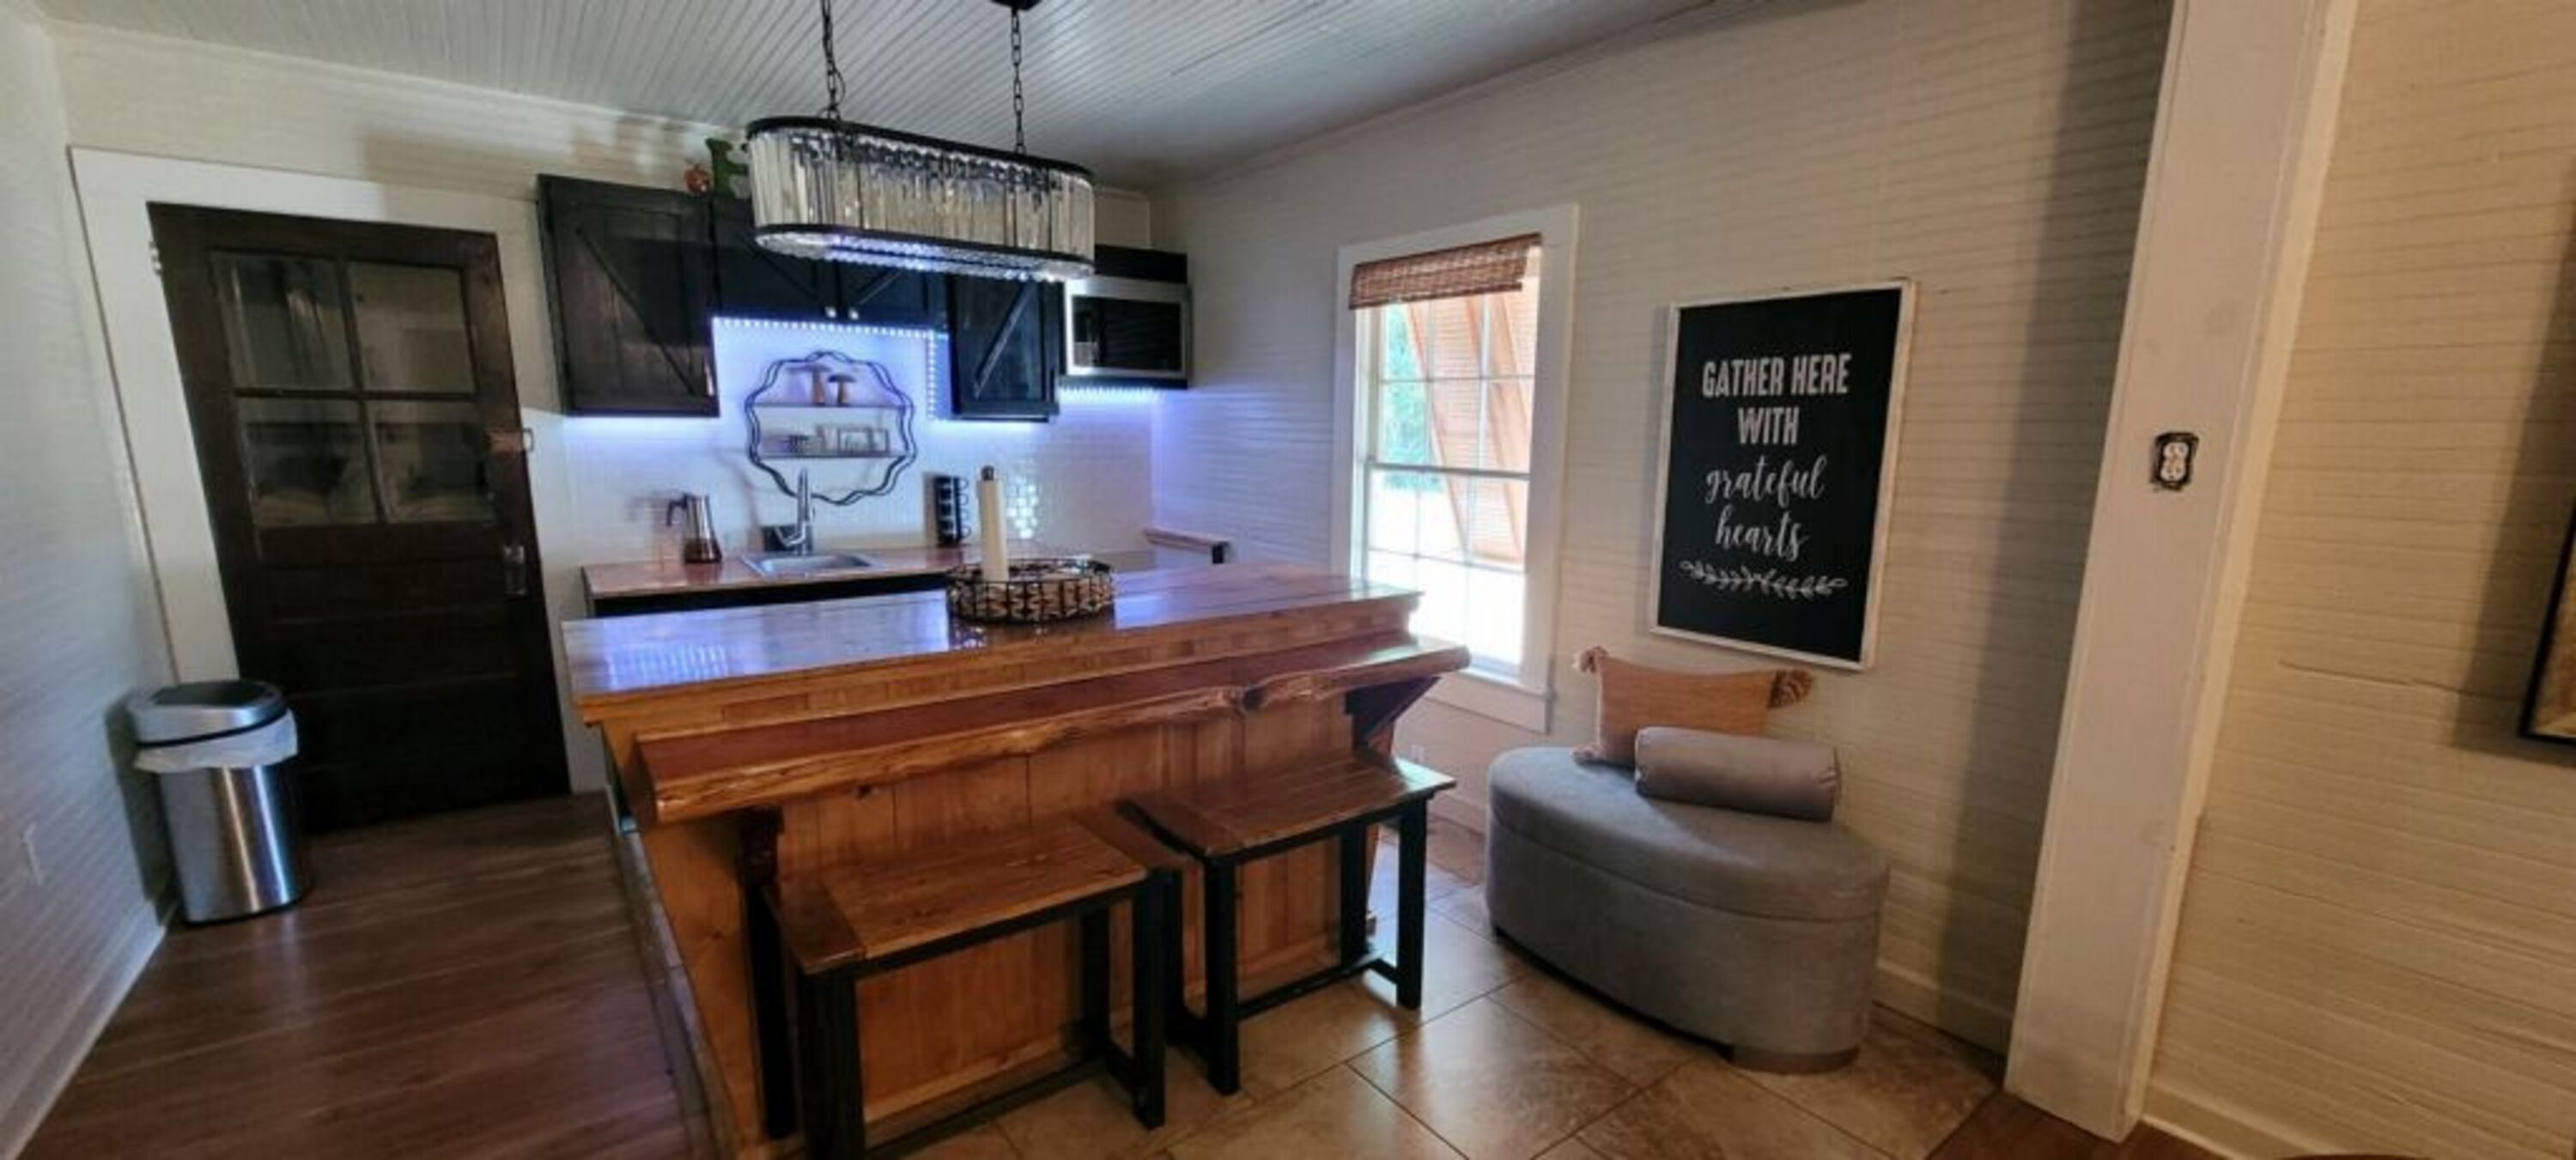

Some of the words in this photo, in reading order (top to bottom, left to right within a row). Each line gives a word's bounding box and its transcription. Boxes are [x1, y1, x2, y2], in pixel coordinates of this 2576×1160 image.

[1703, 358, 1784, 398] GATHER
[1791, 354, 1851, 395] HERE
[1739, 407, 1800, 445] WITH
[1706, 455, 1827, 507] grateful
[1716, 505, 1809, 562] hearts
